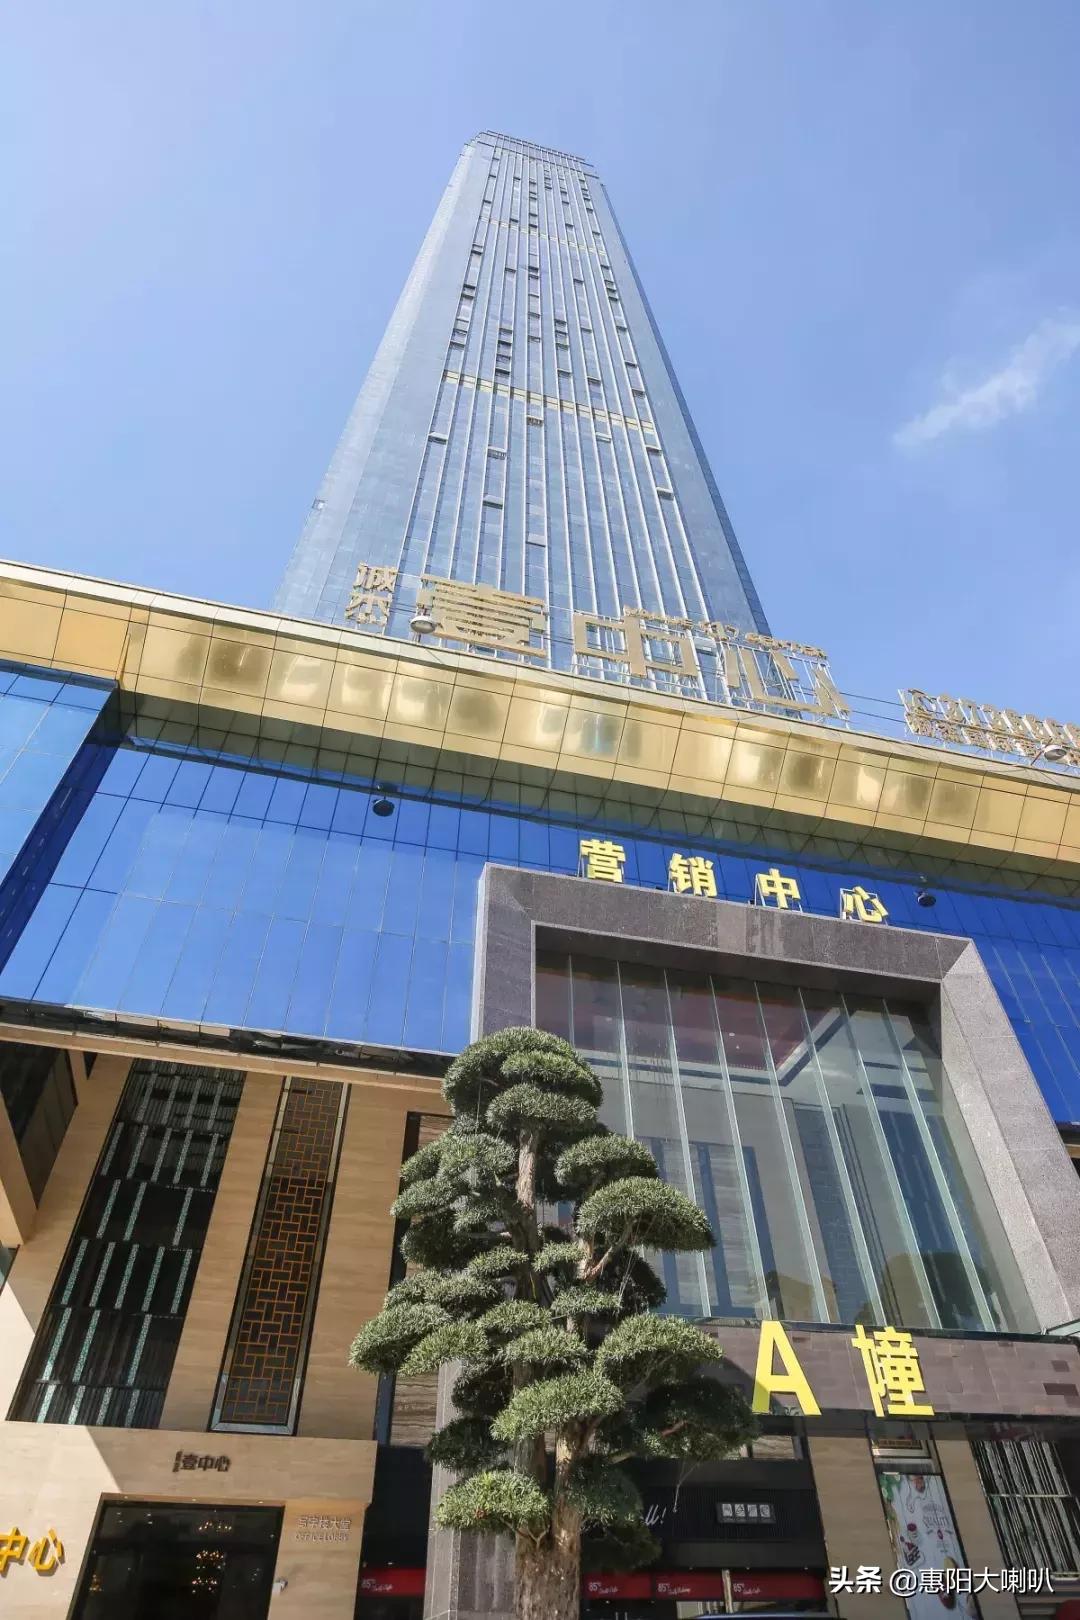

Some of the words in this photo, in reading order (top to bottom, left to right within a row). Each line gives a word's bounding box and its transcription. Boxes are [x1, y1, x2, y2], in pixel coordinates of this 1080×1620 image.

[580, 839, 888, 922] 营销中心
[752, 1320, 822, 1416] A
[851, 1324, 935, 1418] 幢
[0, 1527, 65, 1574] 中心
